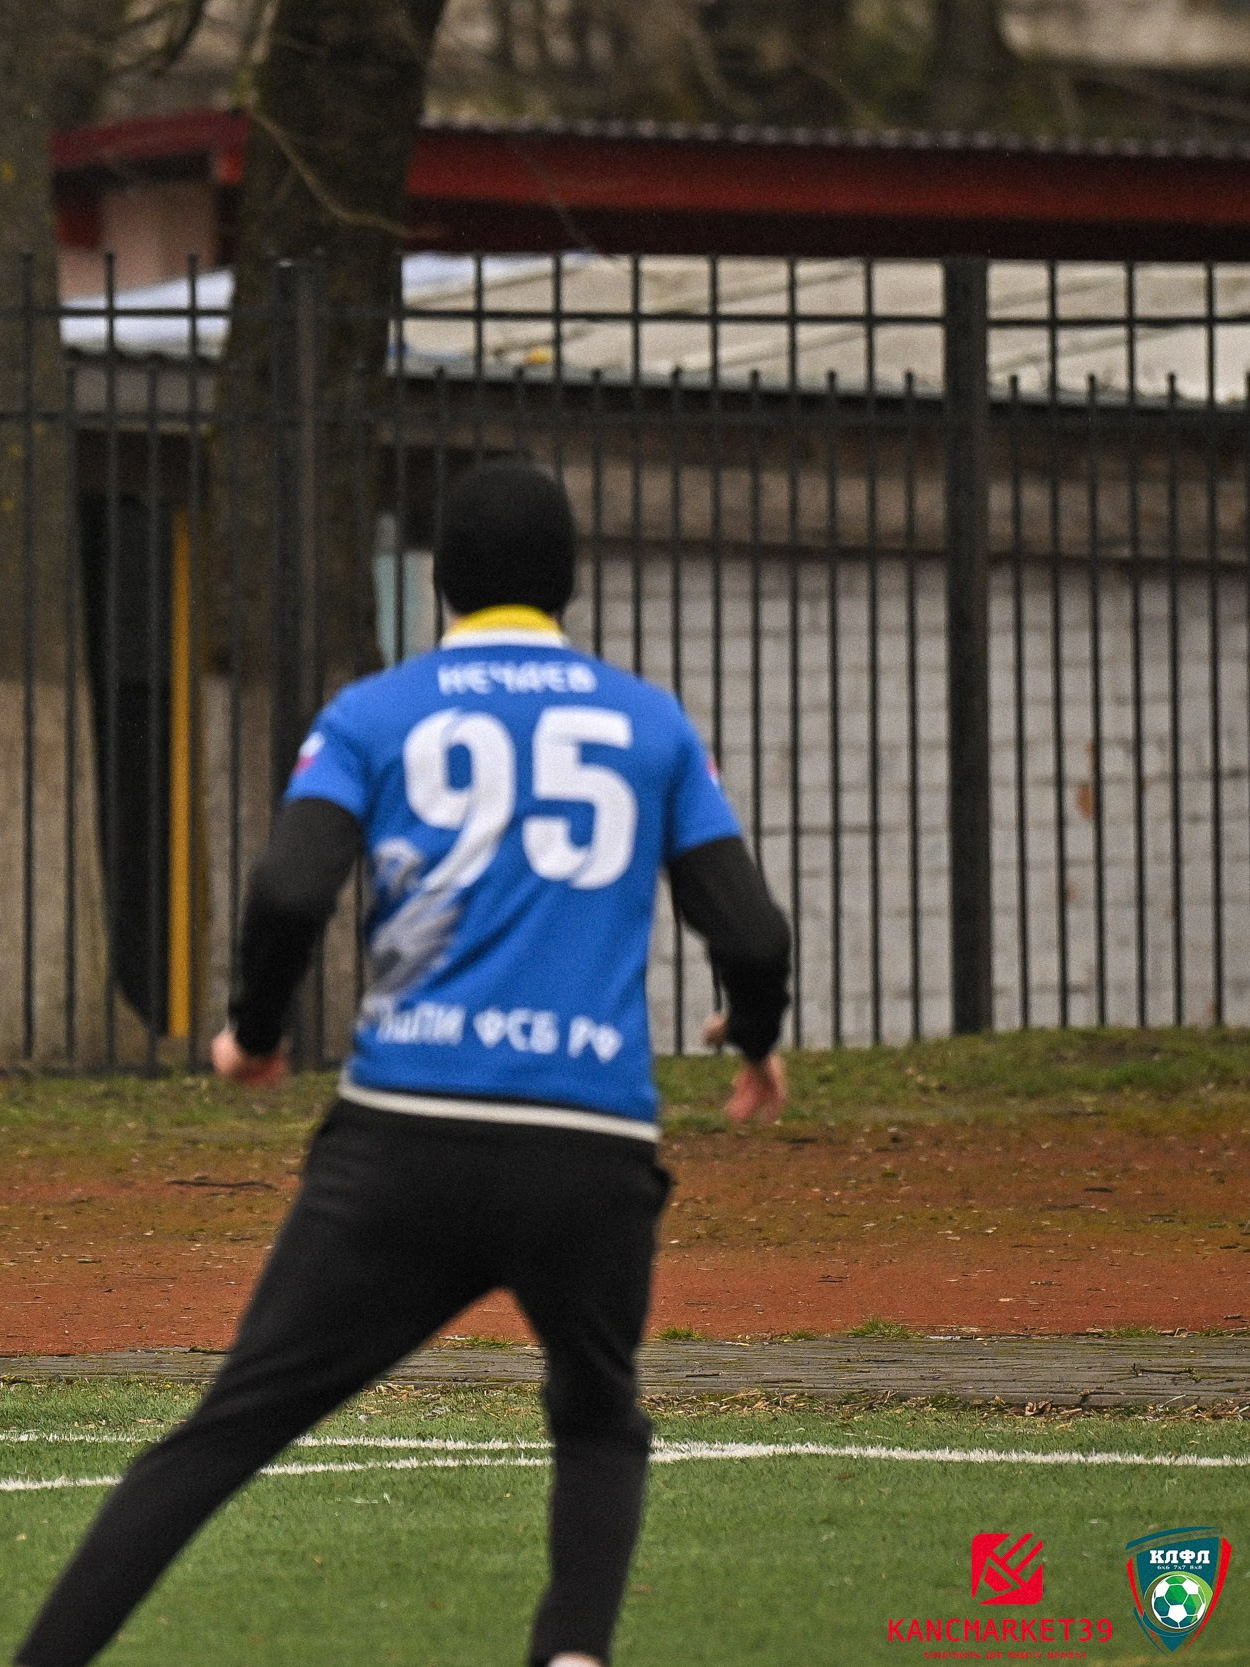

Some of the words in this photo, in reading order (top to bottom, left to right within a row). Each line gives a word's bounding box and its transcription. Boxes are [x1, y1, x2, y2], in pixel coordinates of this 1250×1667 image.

[437, 661, 598, 695] НЕЧАЕВ
[403, 705, 639, 890] 95
[473, 1005, 560, 1055] ФСБ
[568, 1014, 624, 1064] РФ
